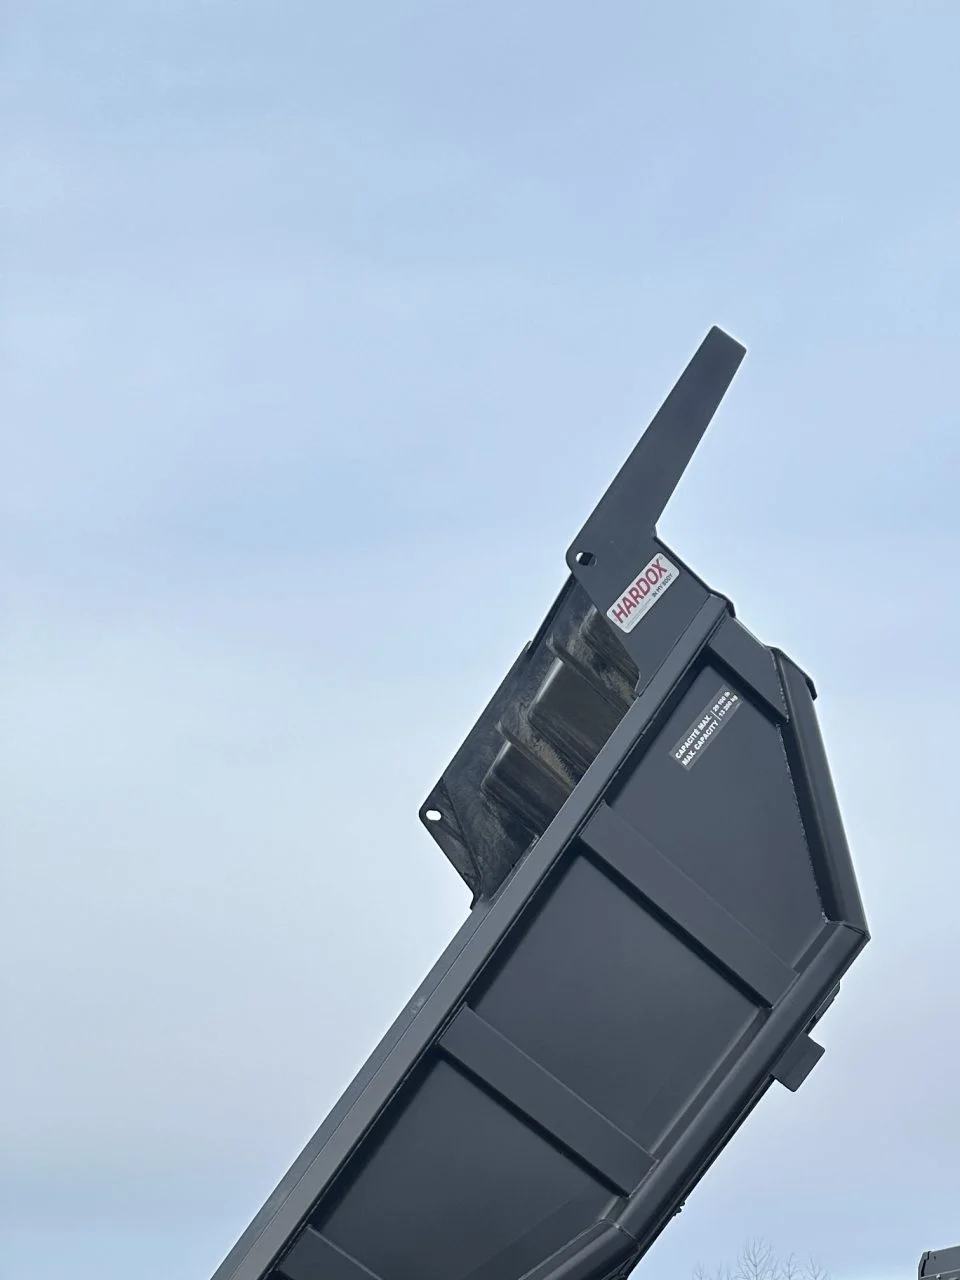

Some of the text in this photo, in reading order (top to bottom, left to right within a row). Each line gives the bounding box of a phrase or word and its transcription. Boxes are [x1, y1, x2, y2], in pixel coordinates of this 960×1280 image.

[612, 559, 667, 623] HARDOX
[675, 728, 700, 759] CAPACITÉ
[697, 715, 712, 731] MAX.
[682, 750, 697, 766] MAX.
[694, 720, 719, 750] CAPACITY
